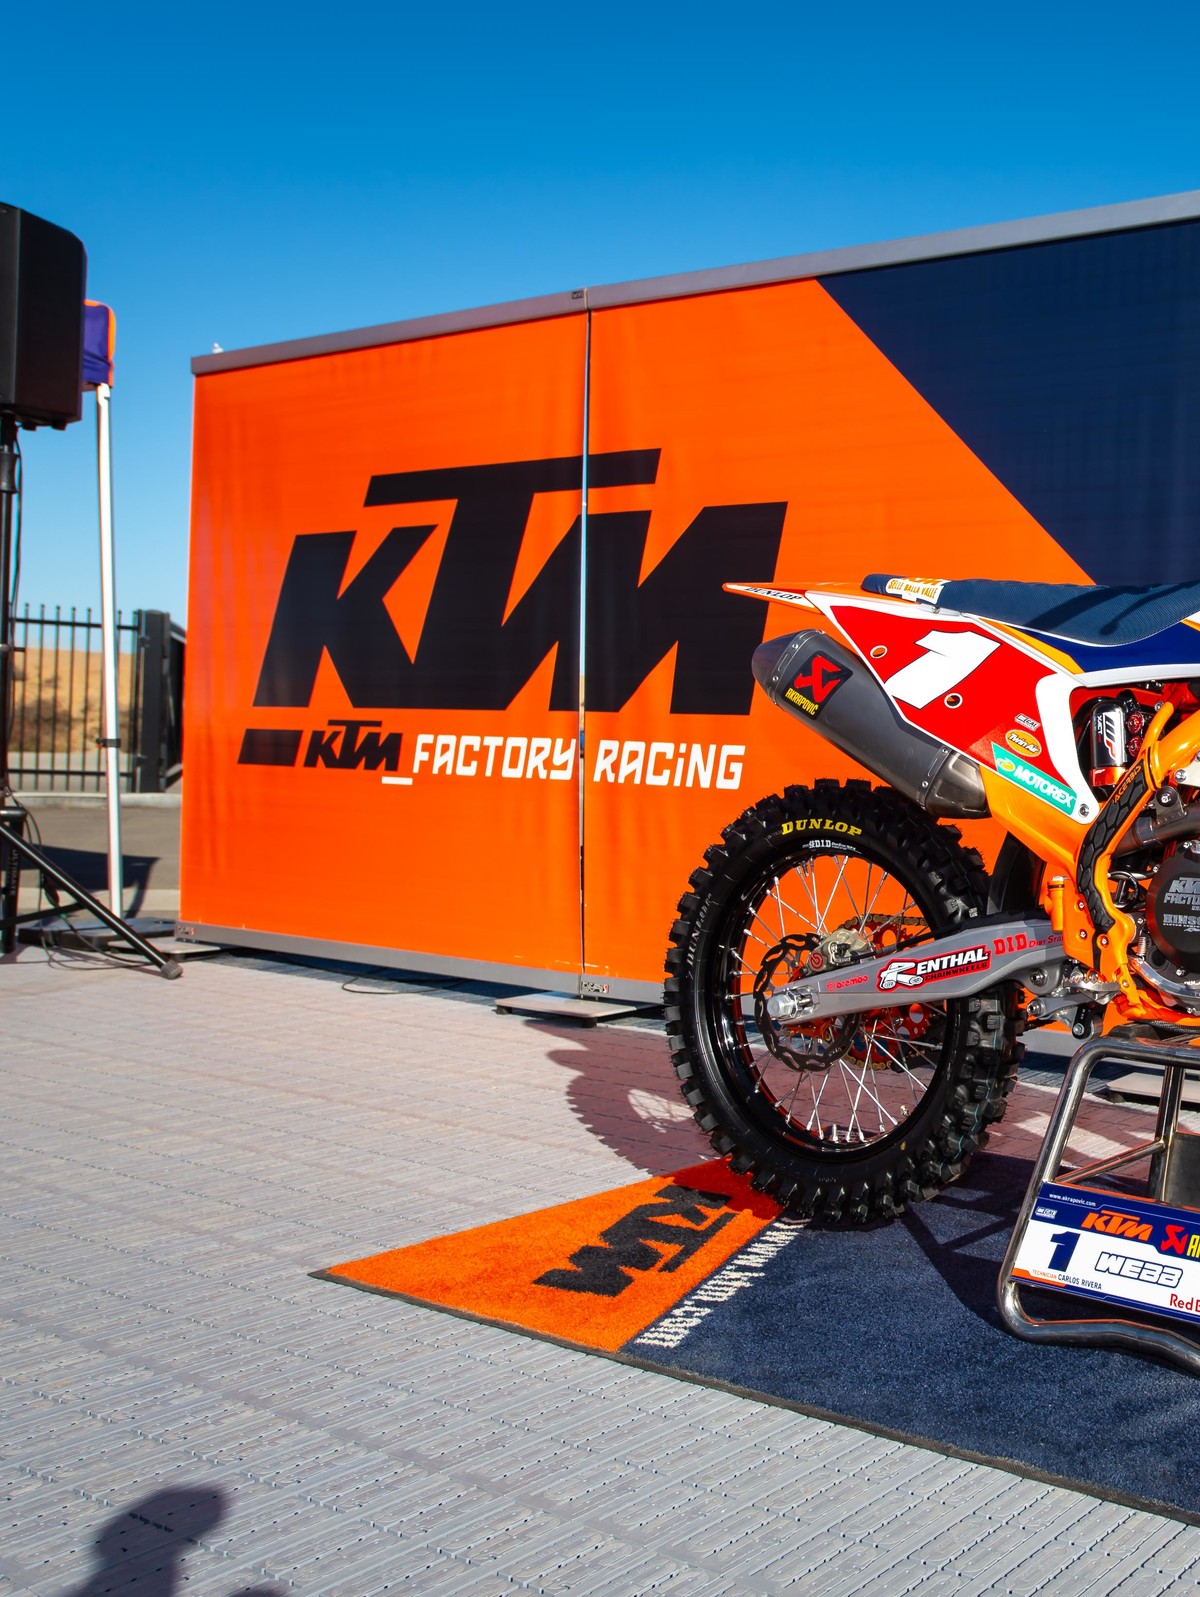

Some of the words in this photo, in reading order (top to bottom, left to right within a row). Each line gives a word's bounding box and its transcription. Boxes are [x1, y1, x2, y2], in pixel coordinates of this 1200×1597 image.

[252, 447, 789, 716] KTM
[887, 579, 903, 590] SELLE
[744, 586, 803, 601] DUNLOP
[884, 629, 1003, 710] 1
[1008, 732, 1027, 748] Twin
[1025, 742, 1040, 754] Air
[1013, 764, 1076, 808] MOTOREX
[781, 818, 862, 836] DUNLOP
[925, 962, 988, 980] CHAINWHEELS
[836, 975, 869, 989] brembo
[1049, 1192, 1097, 1207] www.akrapovic.com
[1081, 1209, 1153, 1242] KTM
[1047, 1230, 1081, 1273] 1
[1094, 1251, 1184, 1289] WEBB
[1032, 1268, 1057, 1280] TECHNICIAN
[1057, 1273, 1080, 1286] CARLOS
[1081, 1278, 1102, 1290] RIVERA
[1169, 1293, 1194, 1309] Red
